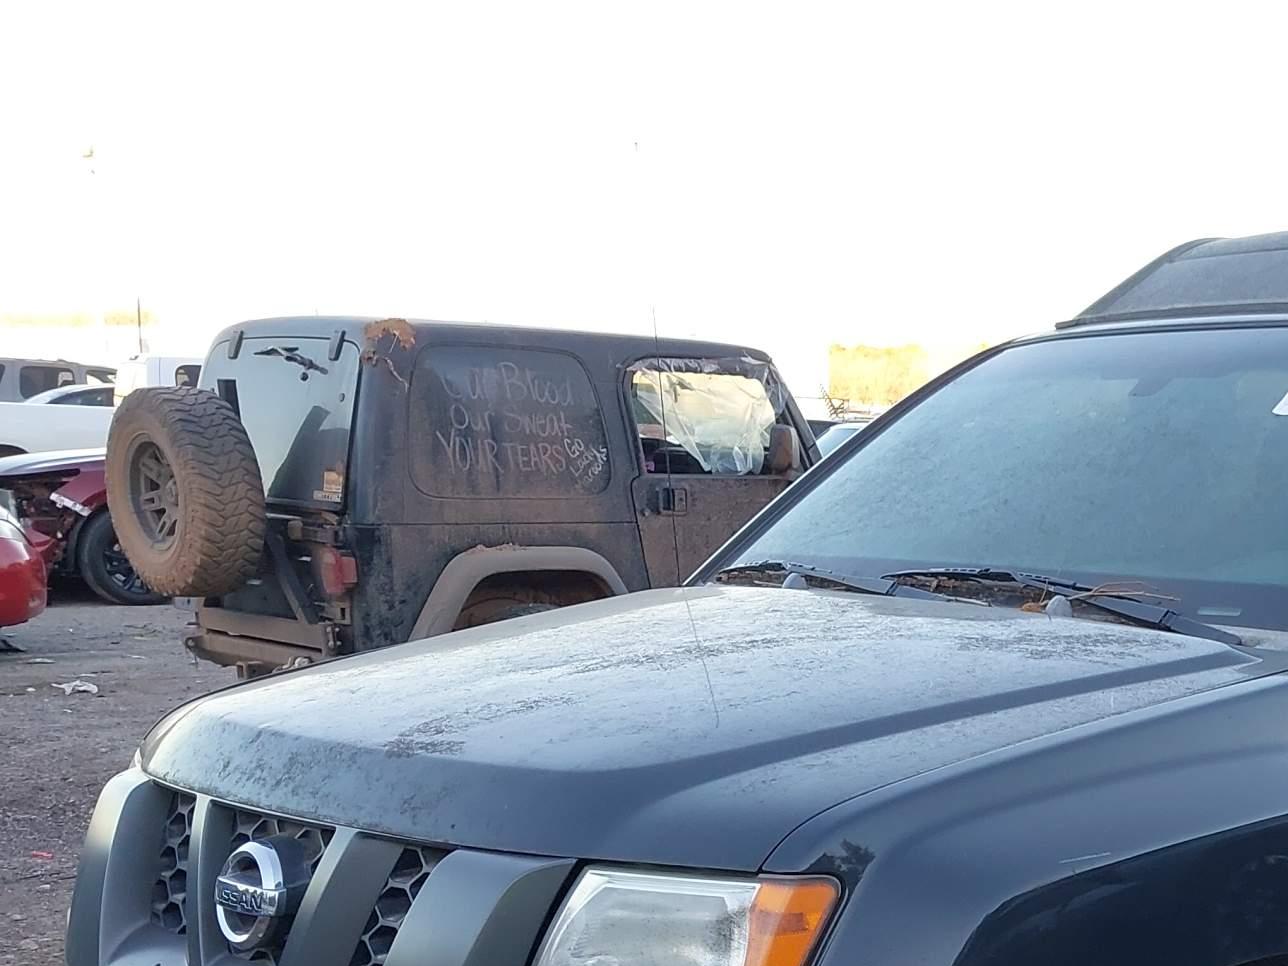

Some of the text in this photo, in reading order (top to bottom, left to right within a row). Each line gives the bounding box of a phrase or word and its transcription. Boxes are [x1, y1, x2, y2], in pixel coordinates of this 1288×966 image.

[450, 402, 495, 432] Our
[436, 428, 567, 476] YOUR TEARS
[217, 881, 264, 912] SSAN
